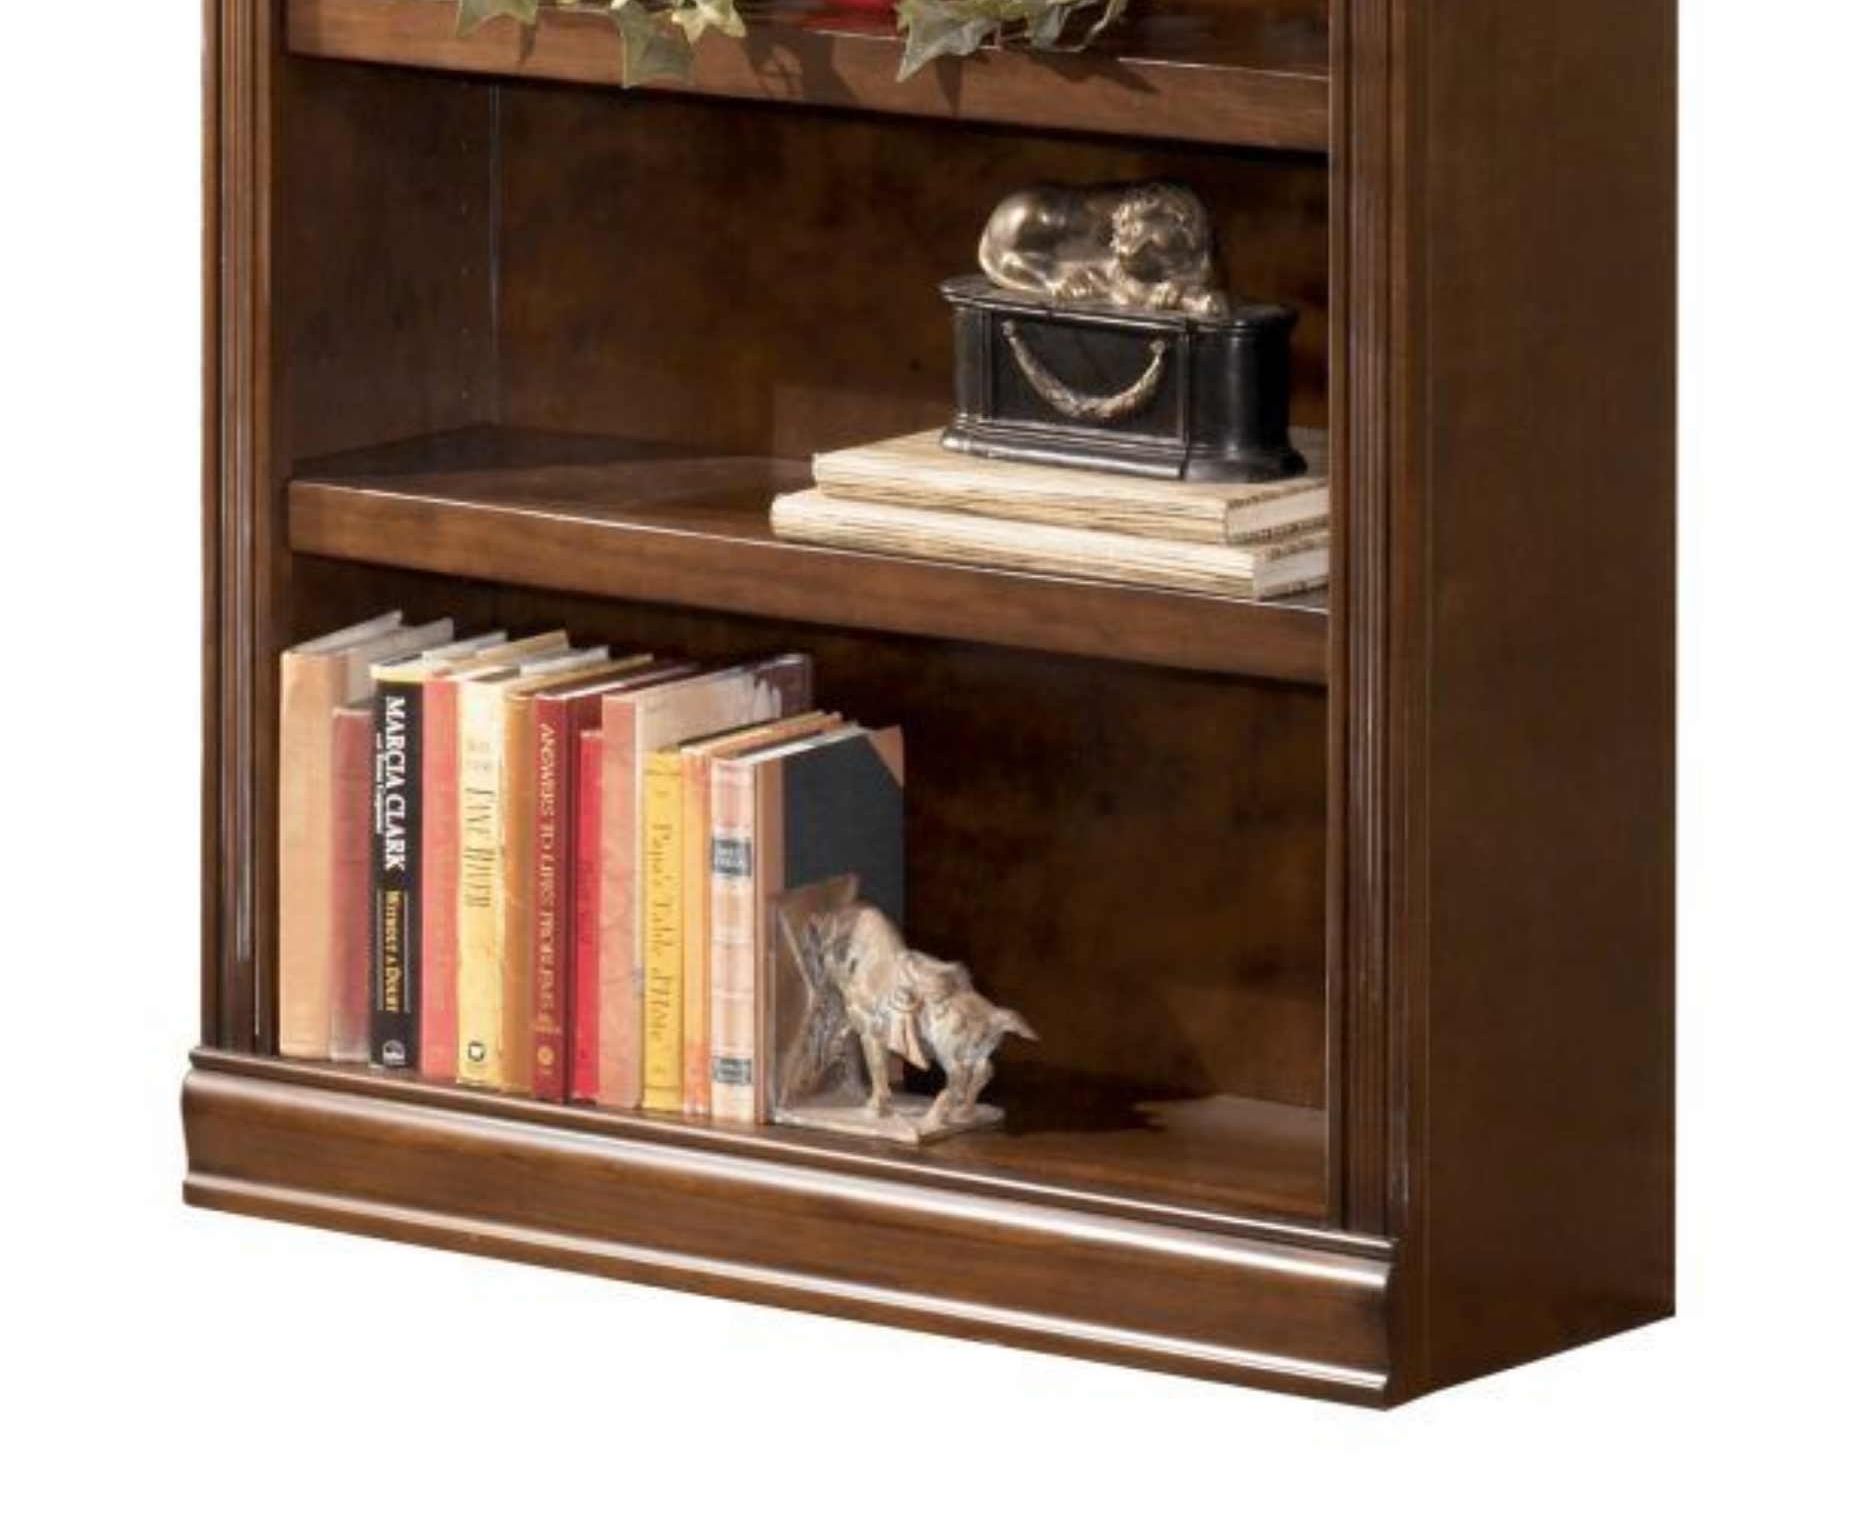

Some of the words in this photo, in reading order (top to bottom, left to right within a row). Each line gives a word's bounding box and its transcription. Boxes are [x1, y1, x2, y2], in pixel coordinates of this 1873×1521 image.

[385, 696, 407, 789] MARCIA
[539, 722, 556, 817] ANSWERS
[385, 792, 407, 871] CLARK
[539, 823, 556, 850] TO
[384, 967, 402, 1013] DOUBT
[385, 954, 399, 967] A
[539, 910, 556, 1009] PROBLEMS
